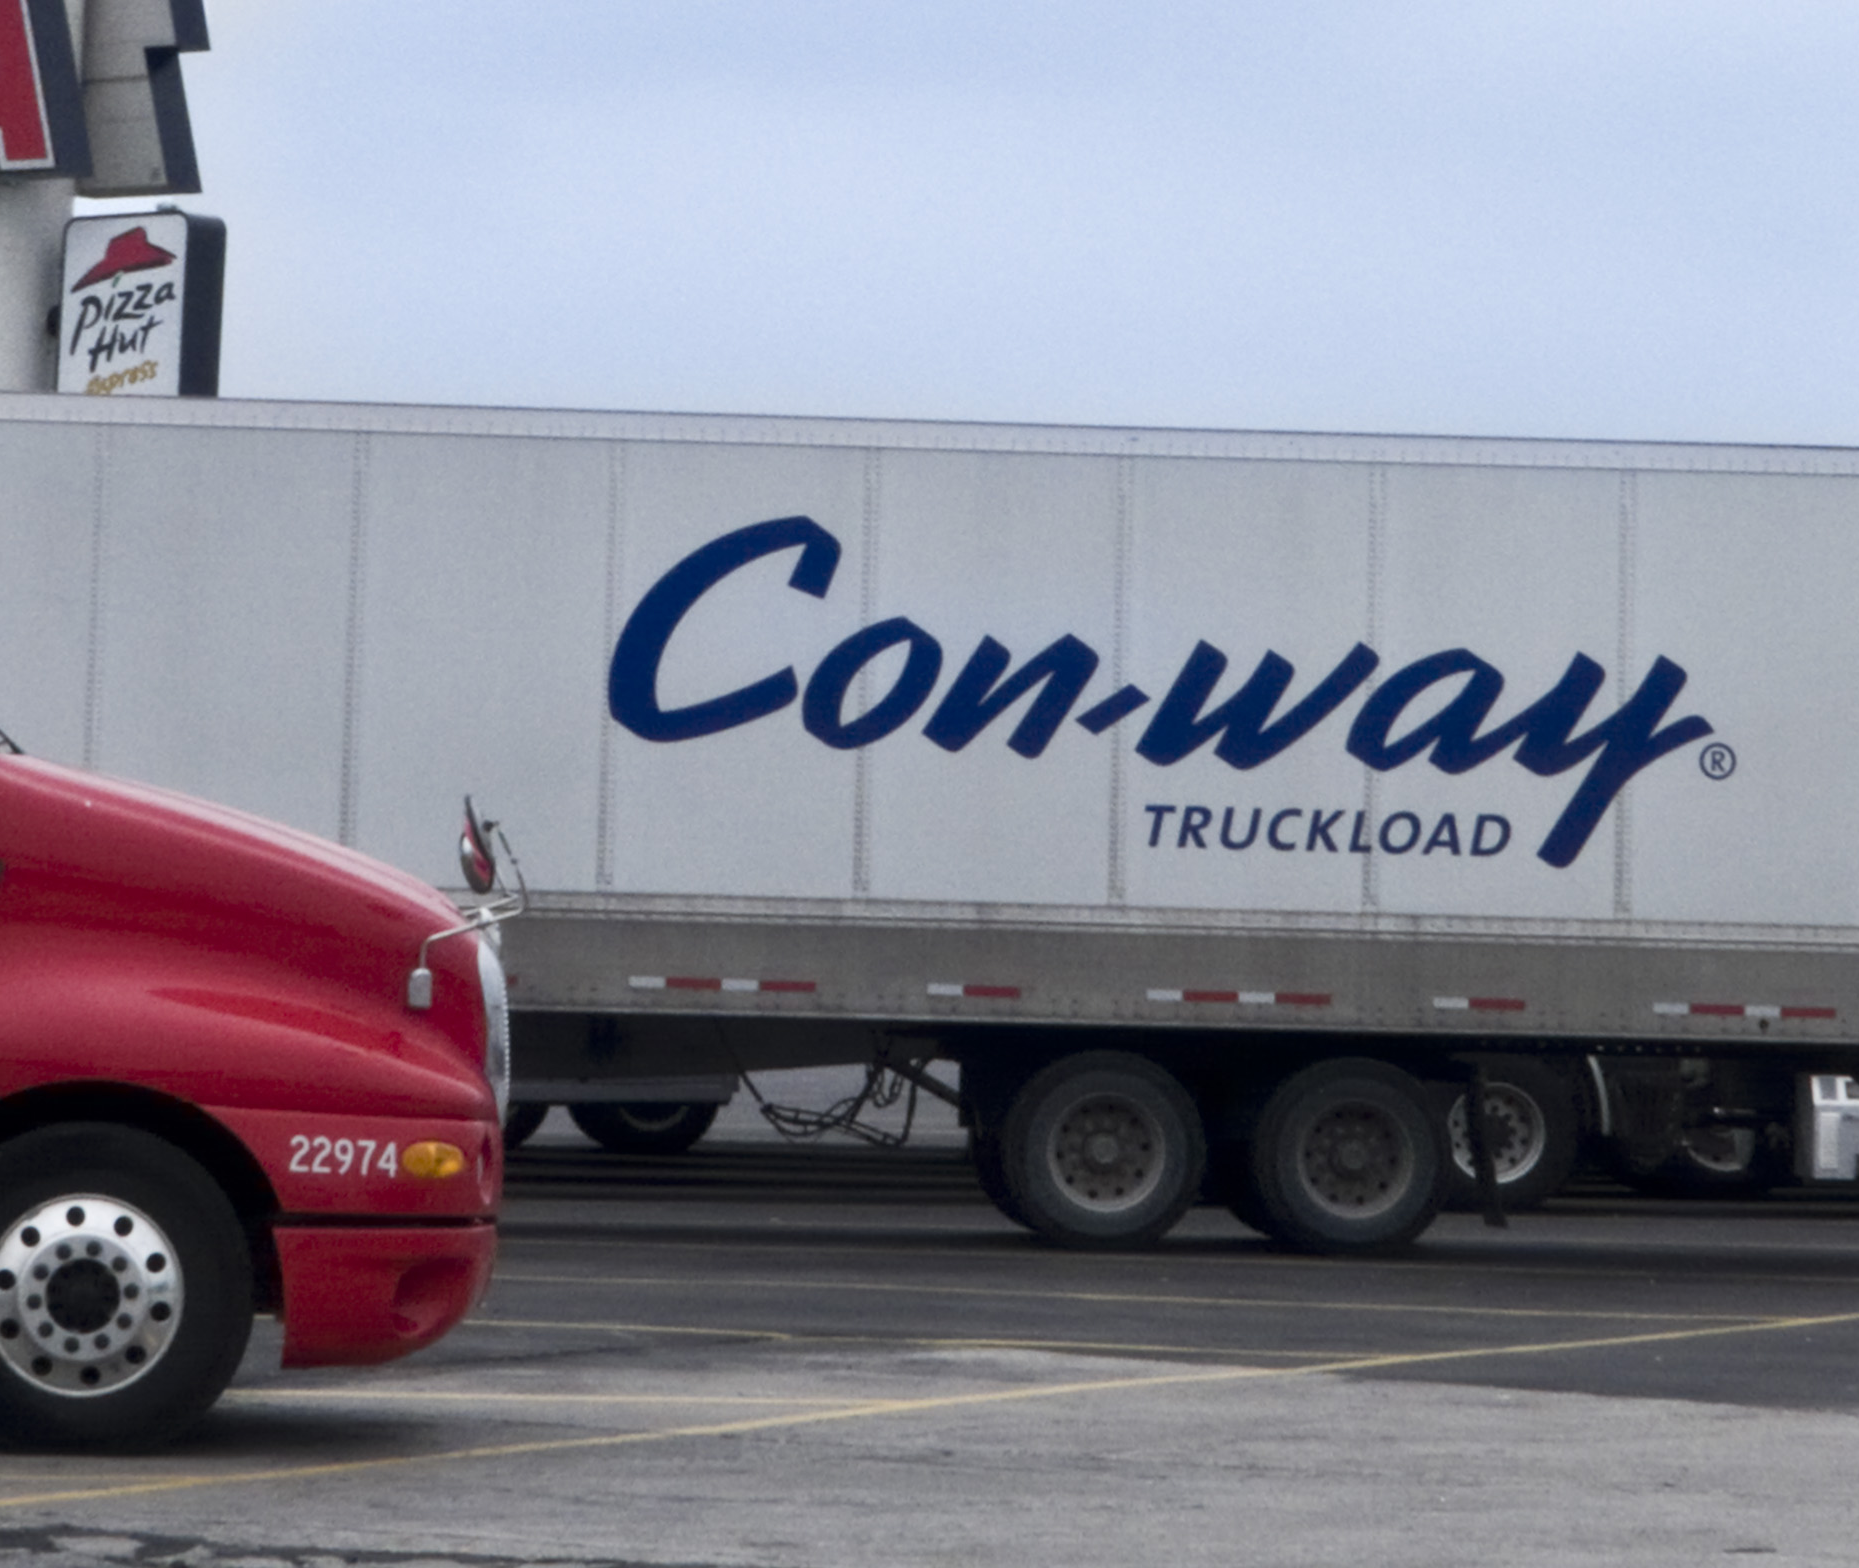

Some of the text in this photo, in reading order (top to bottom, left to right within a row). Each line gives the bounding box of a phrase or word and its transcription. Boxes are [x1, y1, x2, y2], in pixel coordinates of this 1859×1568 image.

[69, 272, 177, 356] Pizza
[87, 314, 164, 374] Hut
[605, 513, 1715, 869] Con-way
[1143, 804, 1513, 857] TRUCKLOAD
[287, 1134, 400, 1179] 22974
